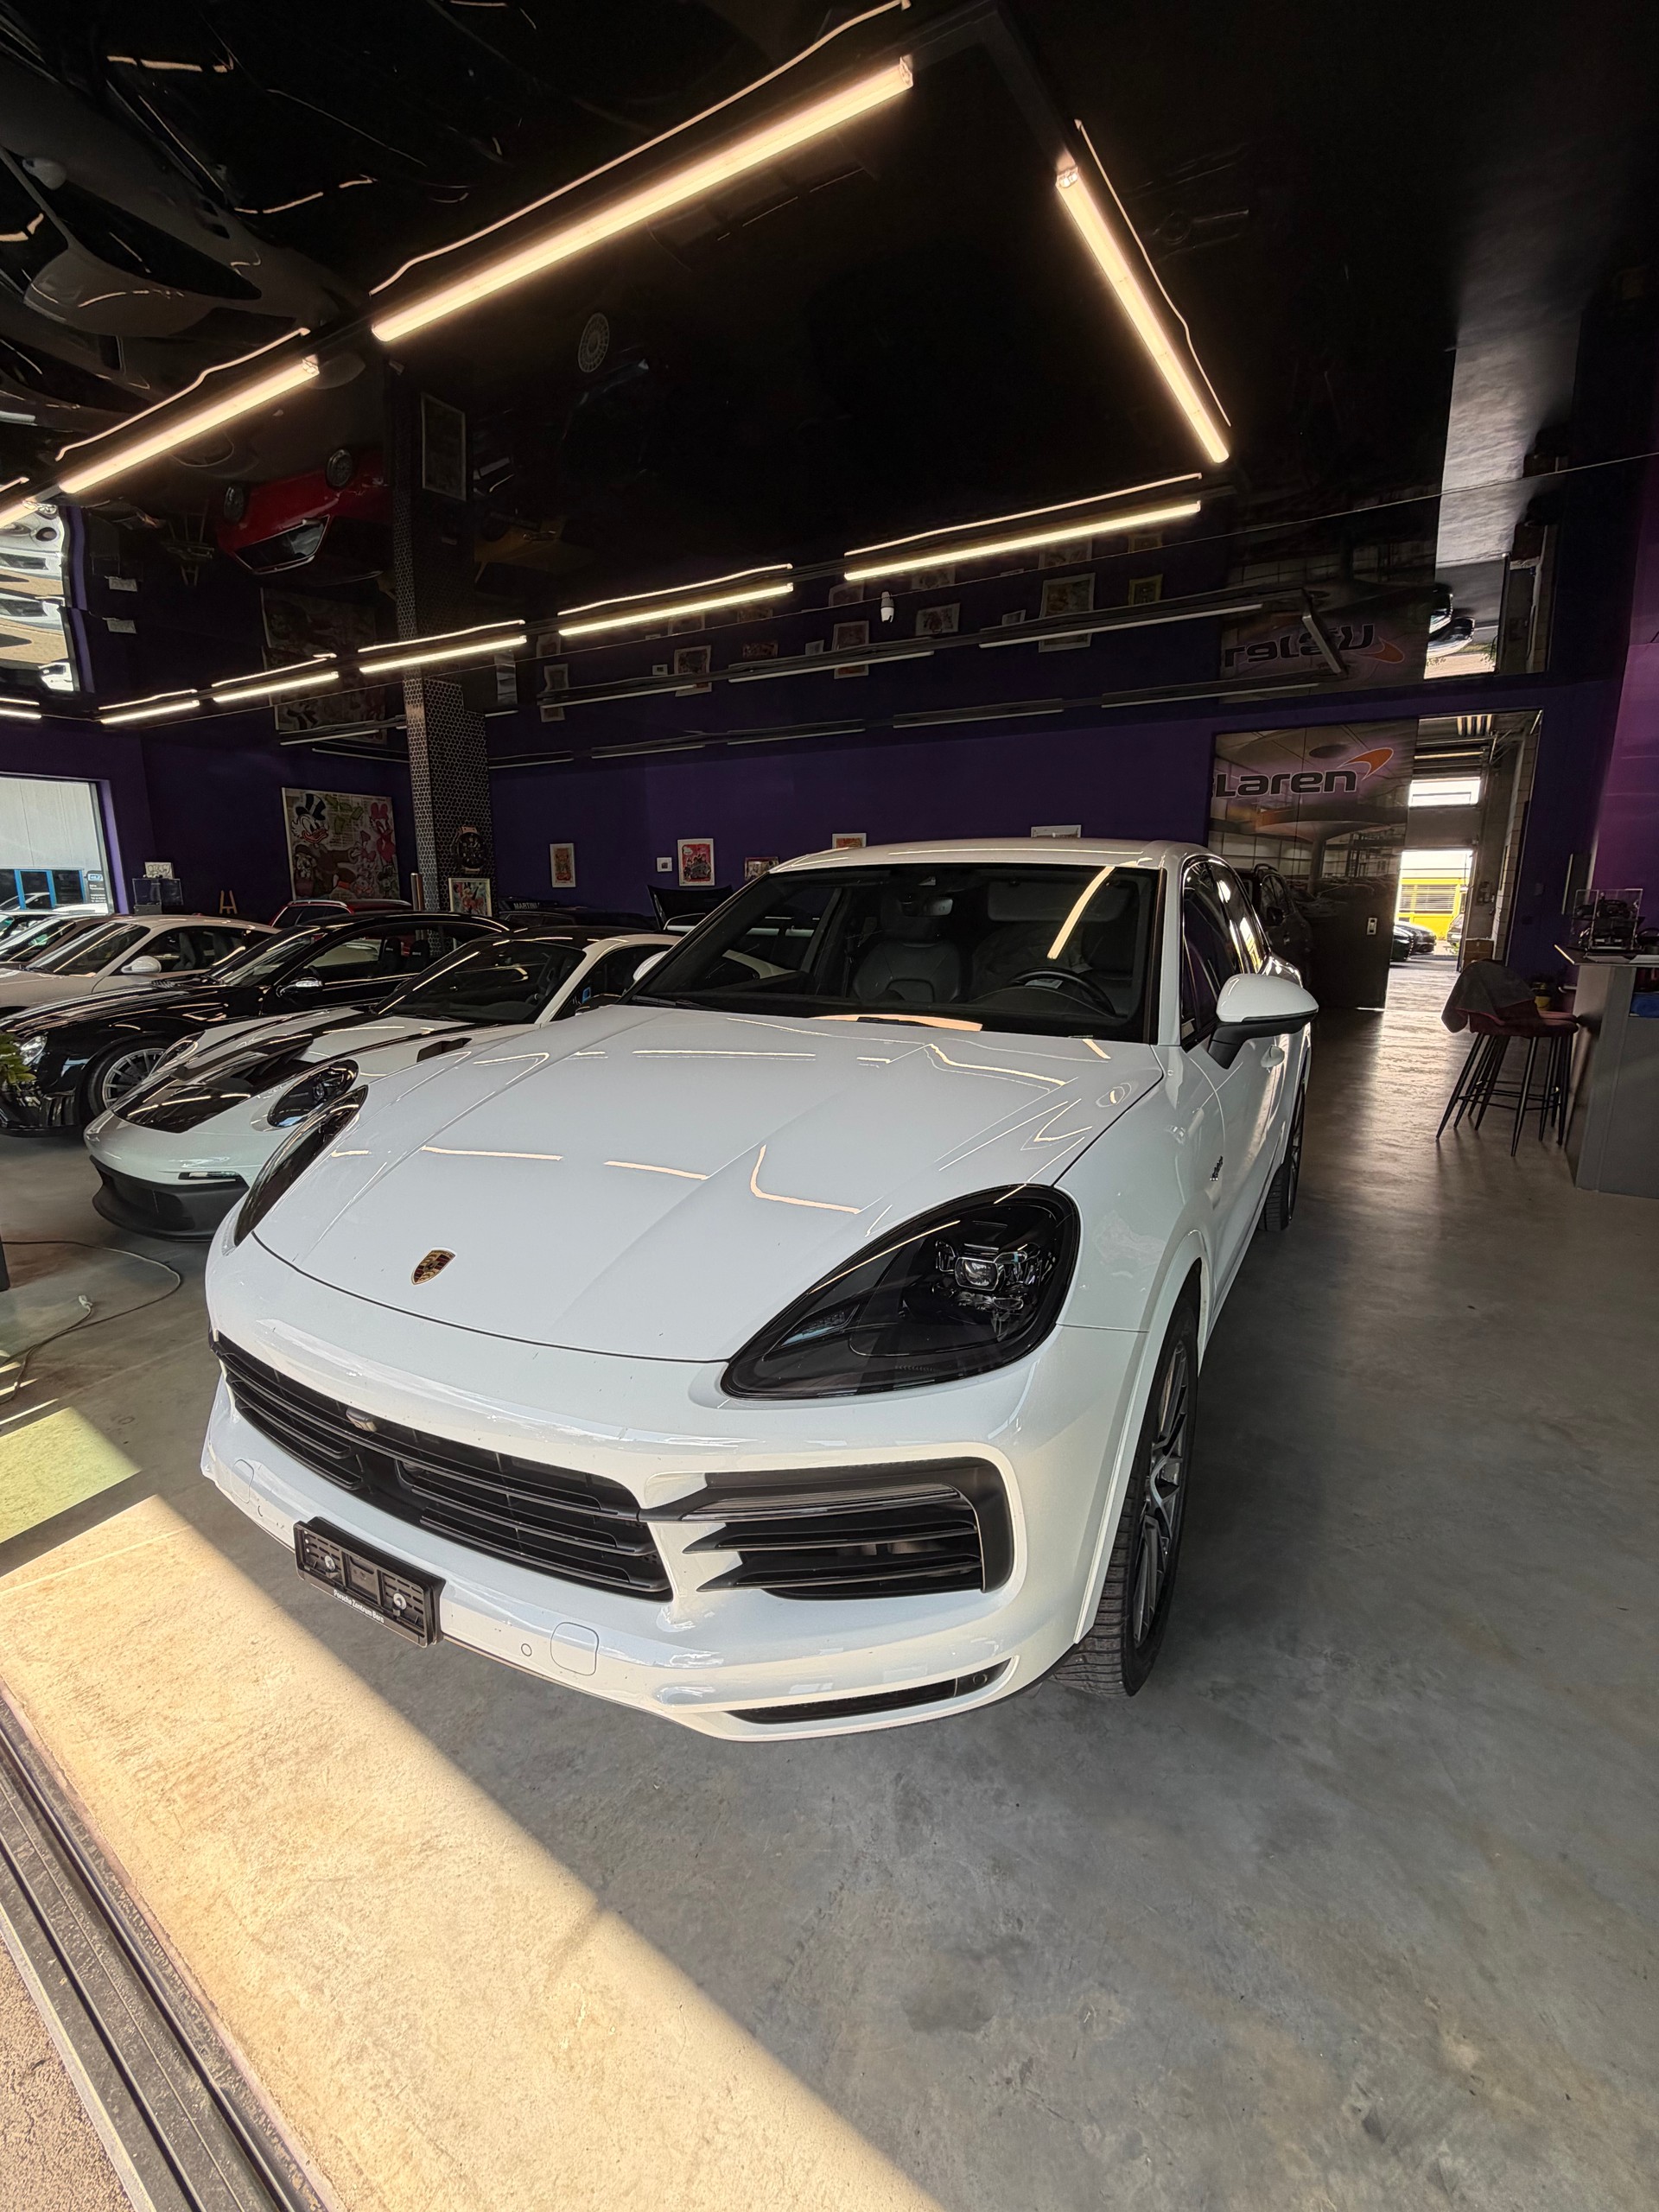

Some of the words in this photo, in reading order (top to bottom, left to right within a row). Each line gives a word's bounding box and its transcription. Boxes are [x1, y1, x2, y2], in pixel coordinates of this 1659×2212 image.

[334, 1588, 353, 1605] Porsche
[352, 1599, 372, 1617] Zentrum
[372, 1610, 385, 1624] Bern
